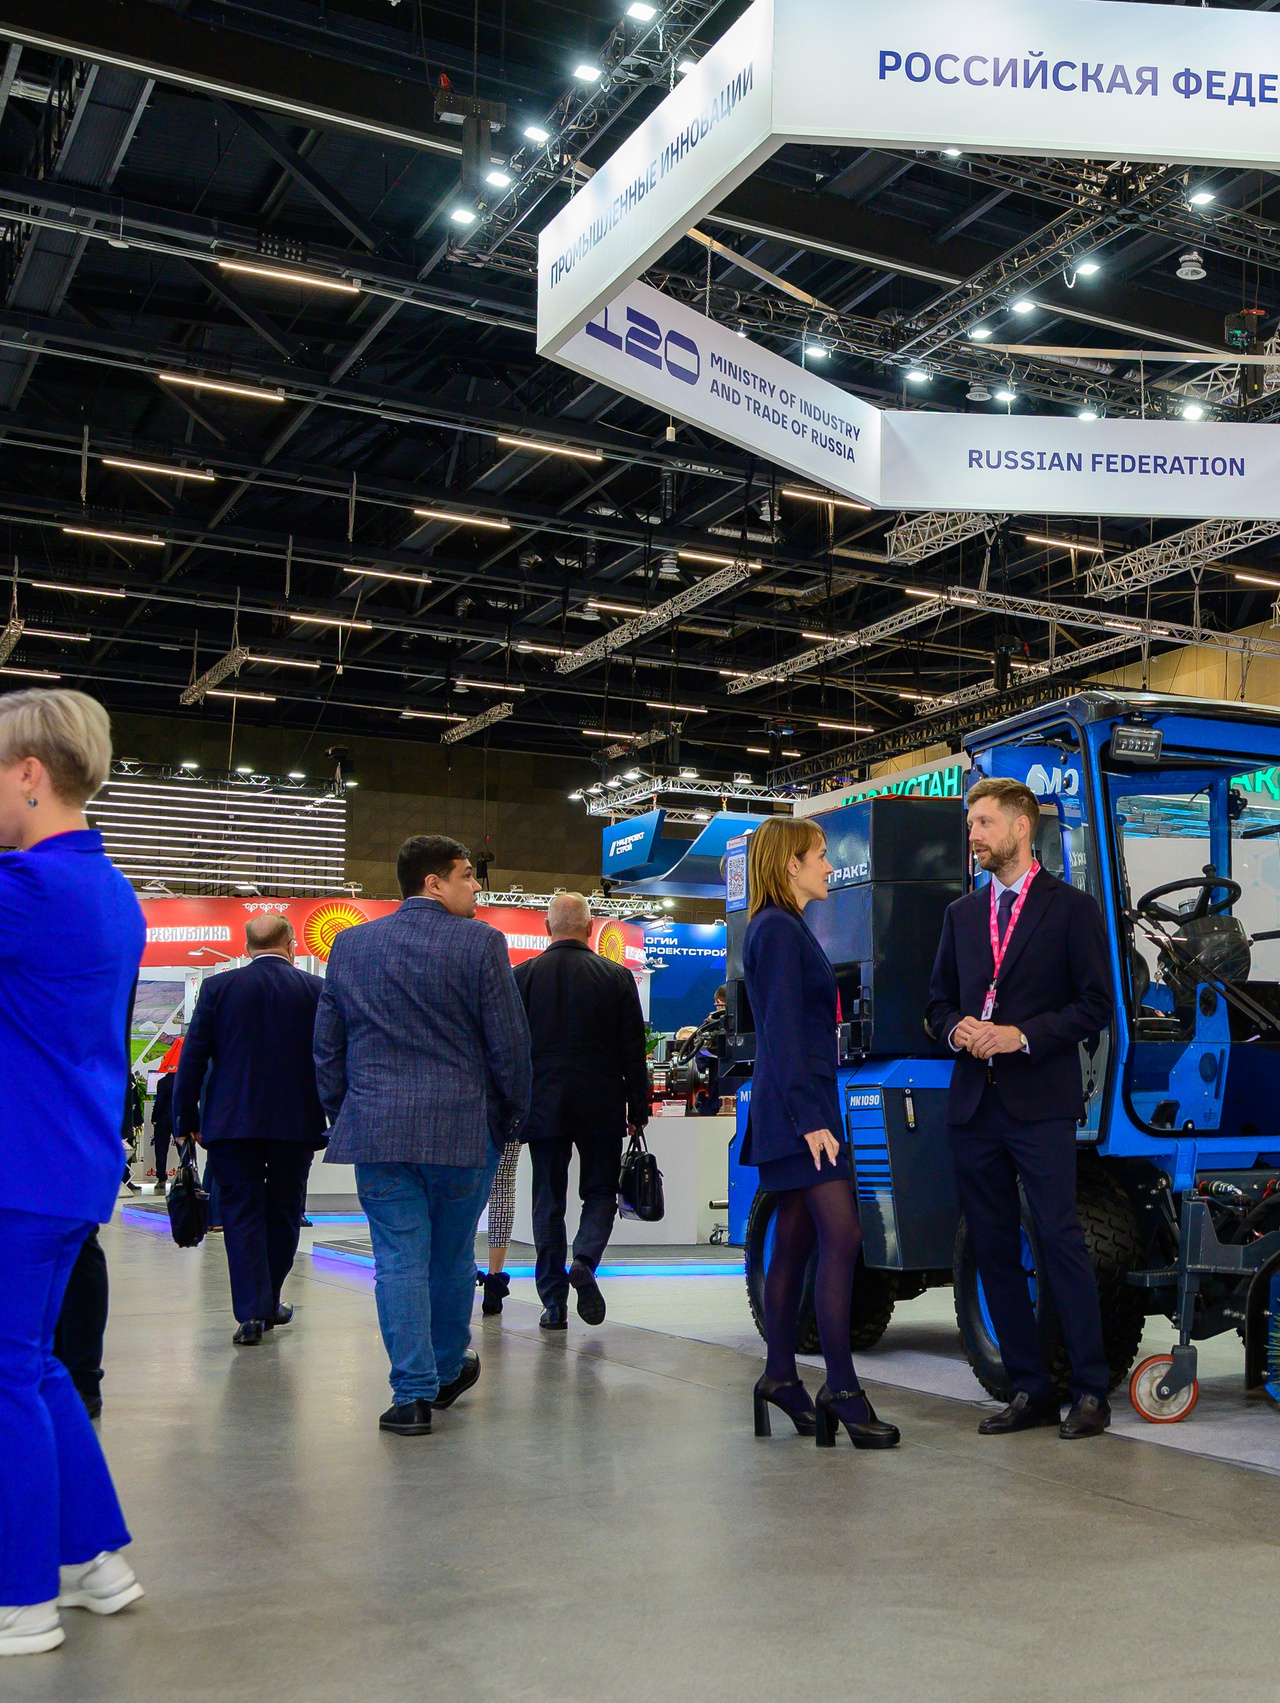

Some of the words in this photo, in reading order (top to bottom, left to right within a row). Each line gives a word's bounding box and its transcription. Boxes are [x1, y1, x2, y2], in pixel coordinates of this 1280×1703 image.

[878, 50, 1159, 98] РОССИЙСКАЯ
[550, 158, 657, 290] ПРОМЫШЛЕННЫЕ
[660, 61, 754, 180] ИННОВАЦИИ
[710, 351, 777, 399] MINISTRY
[779, 388, 797, 407] OF
[799, 398, 861, 443] INDUSTRY
[710, 378, 742, 406] AND
[744, 394, 788, 431] TRADE
[791, 419, 808, 439] OF
[811, 431, 856, 464] RUSSIA
[967, 448, 1083, 473] RUSSIAN
[1090, 452, 1246, 478] FEDERATION
[150, 927, 230, 942] РЕСПУБЛИКА
[643, 936, 678, 946] ОГИИ
